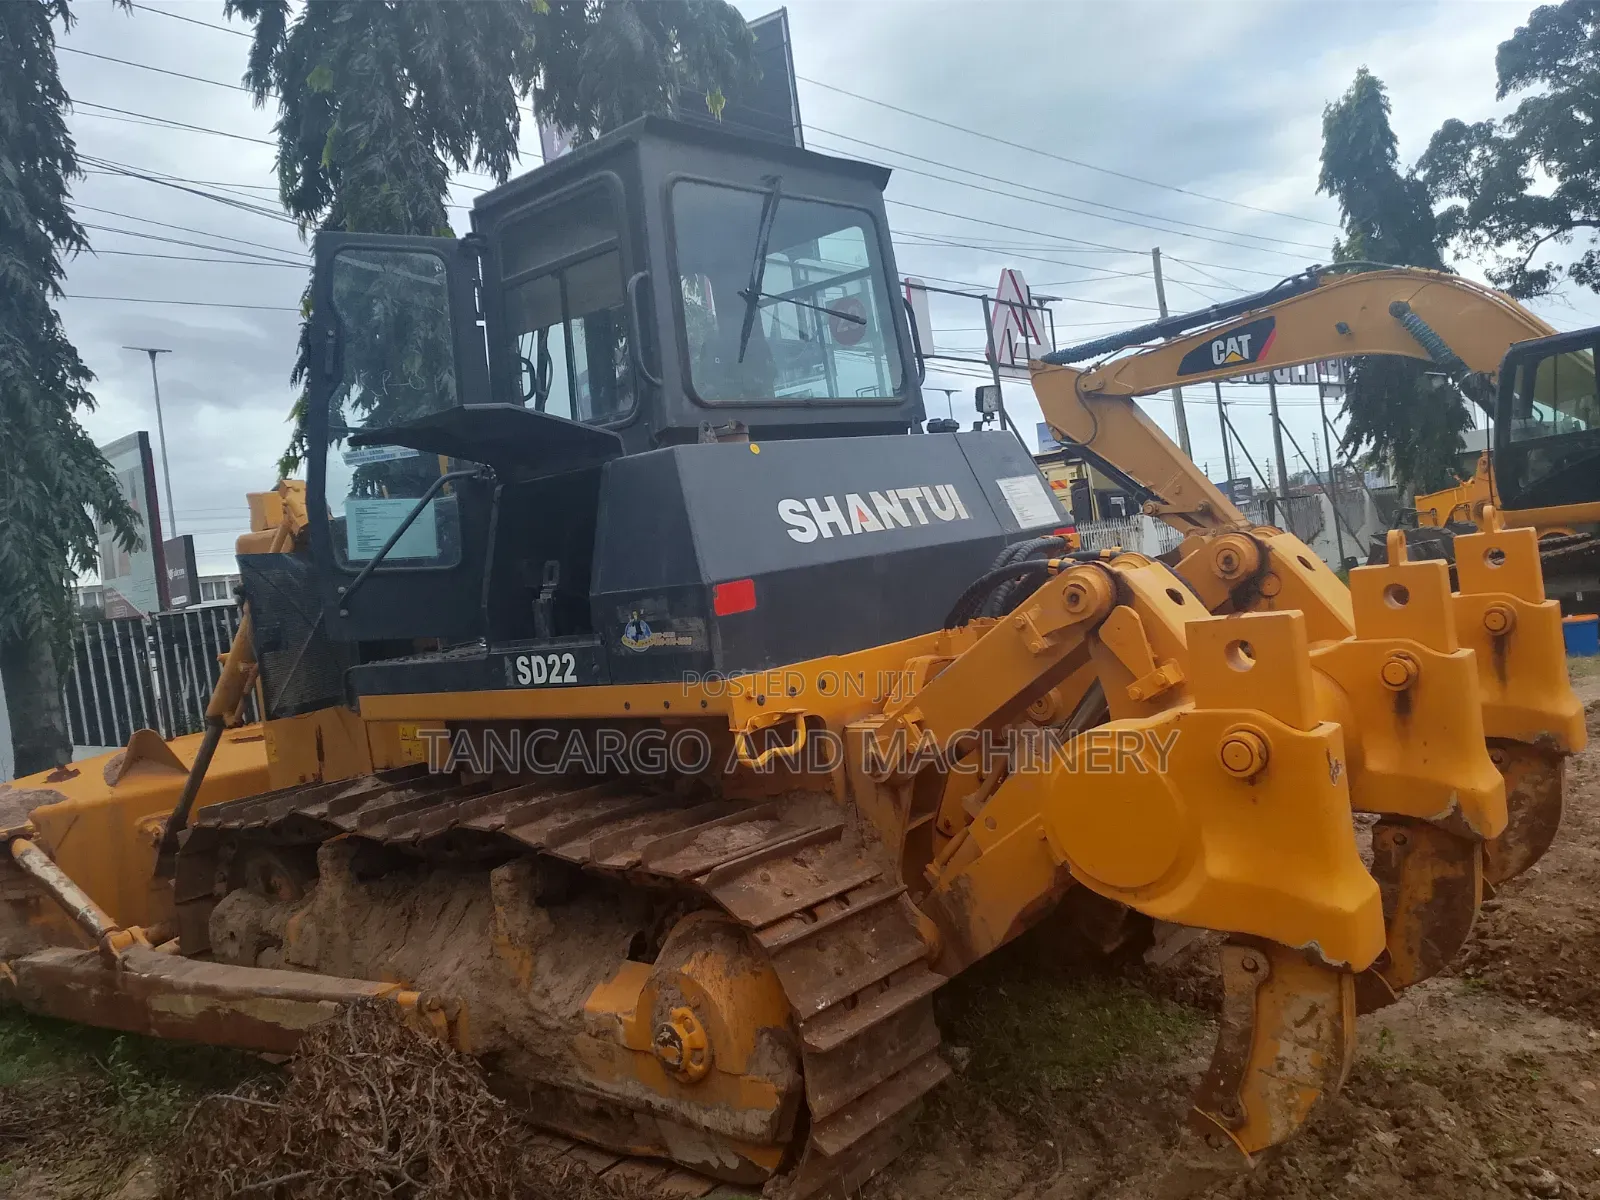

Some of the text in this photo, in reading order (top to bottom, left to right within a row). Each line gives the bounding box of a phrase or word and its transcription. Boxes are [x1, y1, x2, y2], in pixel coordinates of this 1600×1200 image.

[1211, 333, 1252, 366] CAT
[777, 483, 970, 544] SHANTUI
[516, 652, 578, 685] SD22
